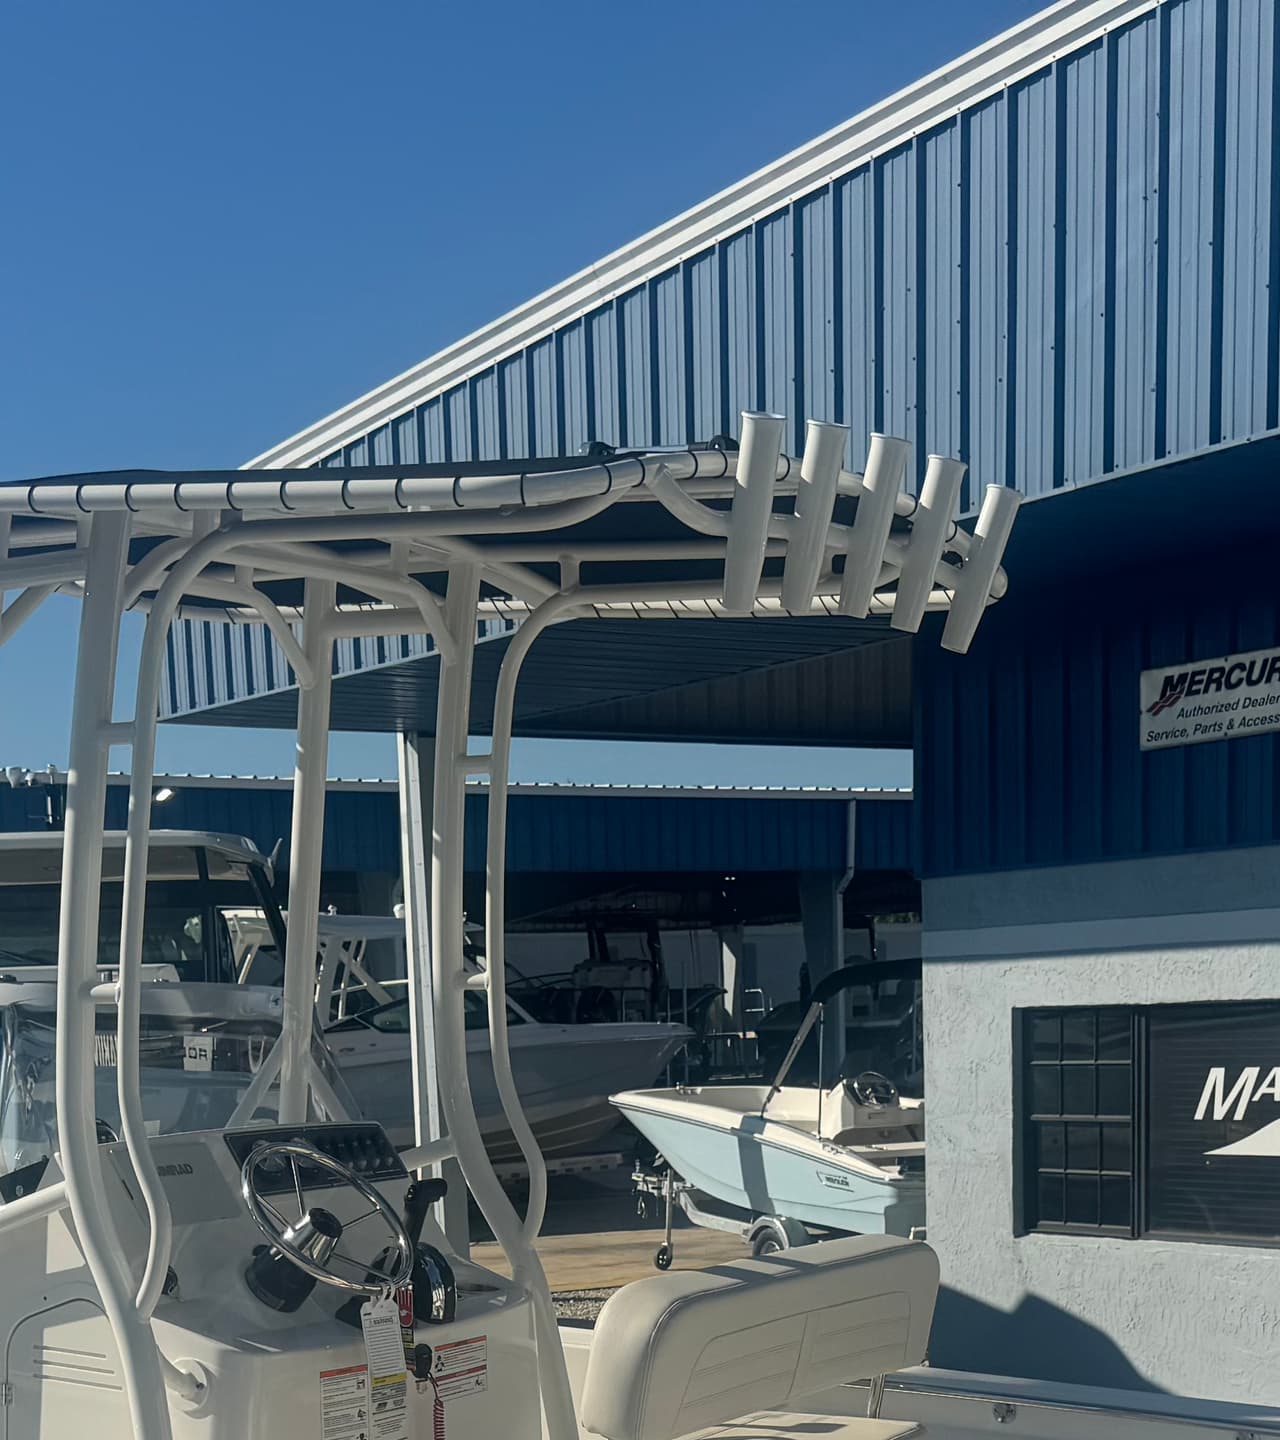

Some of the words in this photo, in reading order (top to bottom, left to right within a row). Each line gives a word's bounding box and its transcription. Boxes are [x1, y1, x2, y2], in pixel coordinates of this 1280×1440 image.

[1176, 700, 1239, 719] Authorized
[1147, 729, 1189, 743] Service,
[1193, 720, 1223, 736] Parts
[1226, 719, 1235, 731] &
